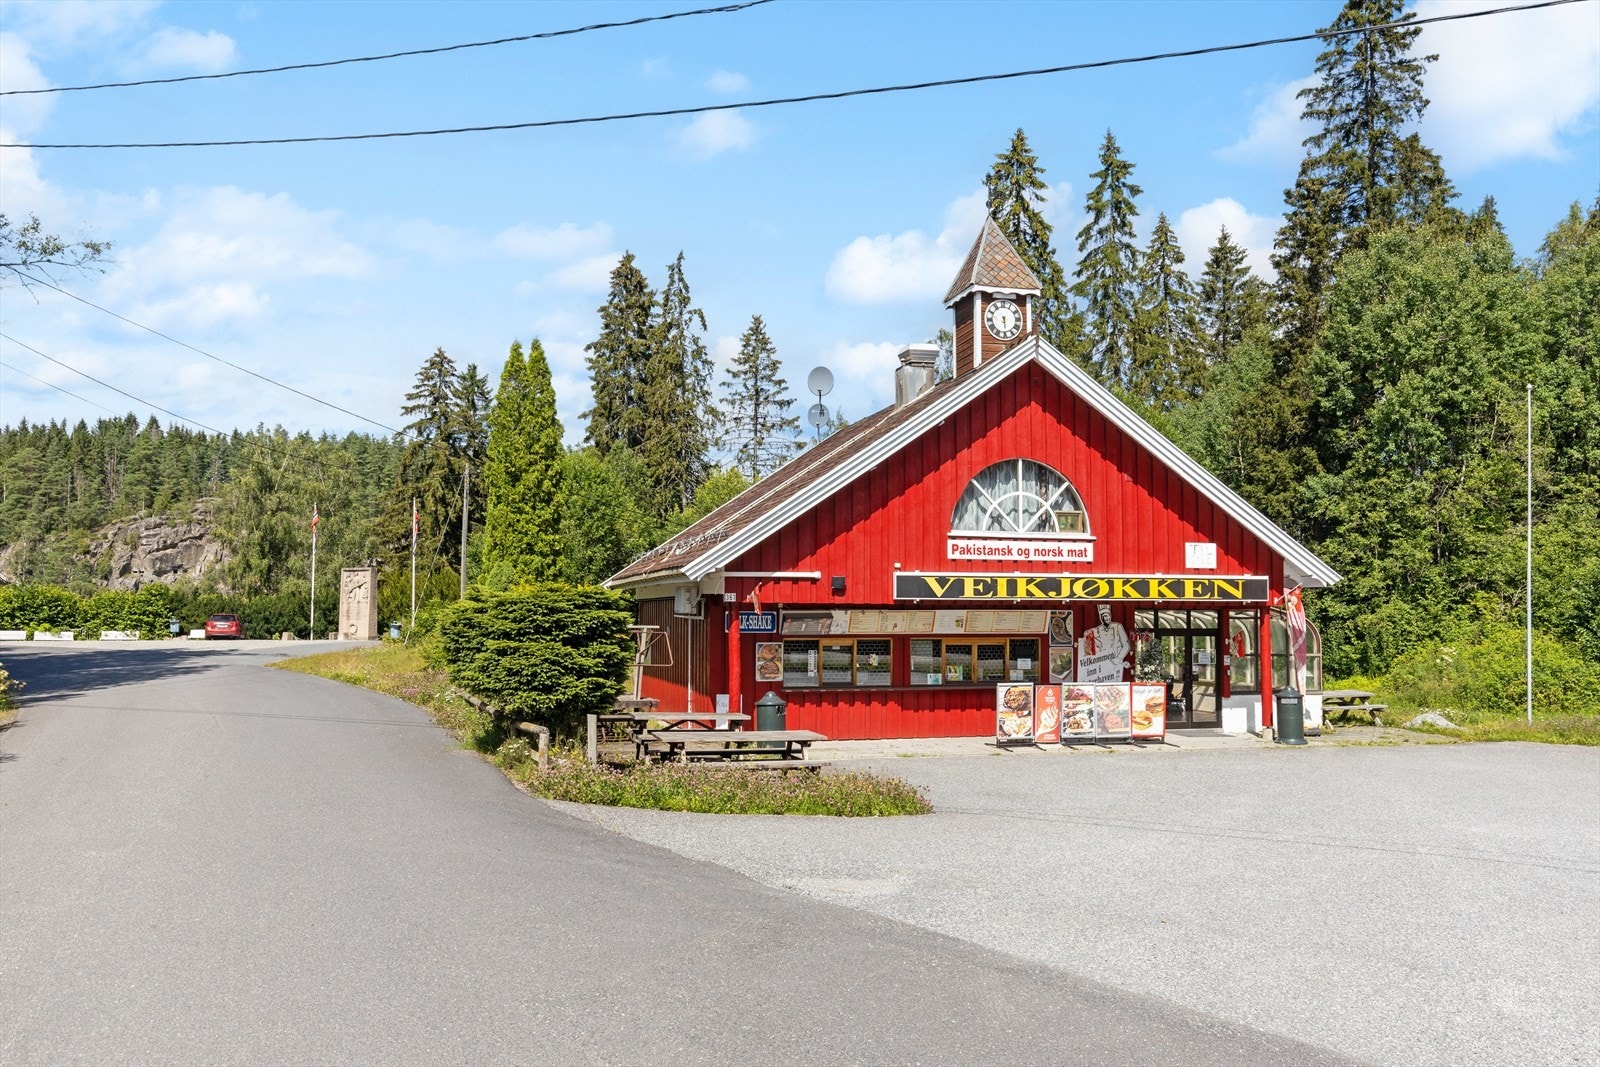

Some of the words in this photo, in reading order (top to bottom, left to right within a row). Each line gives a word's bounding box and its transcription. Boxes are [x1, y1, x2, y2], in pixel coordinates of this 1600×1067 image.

[951, 543, 1013, 556] Pakistansk
[1017, 546, 1030, 558] og
[1034, 546, 1064, 557] norsk
[1067, 547, 1088, 558] mat
[920, 576, 1246, 600] VEIKJØKKEN
[739, 615, 772, 629] LK-SHAKE
[1079, 652, 1116, 668] Velkommen
[1086, 668, 1097, 677] inn
